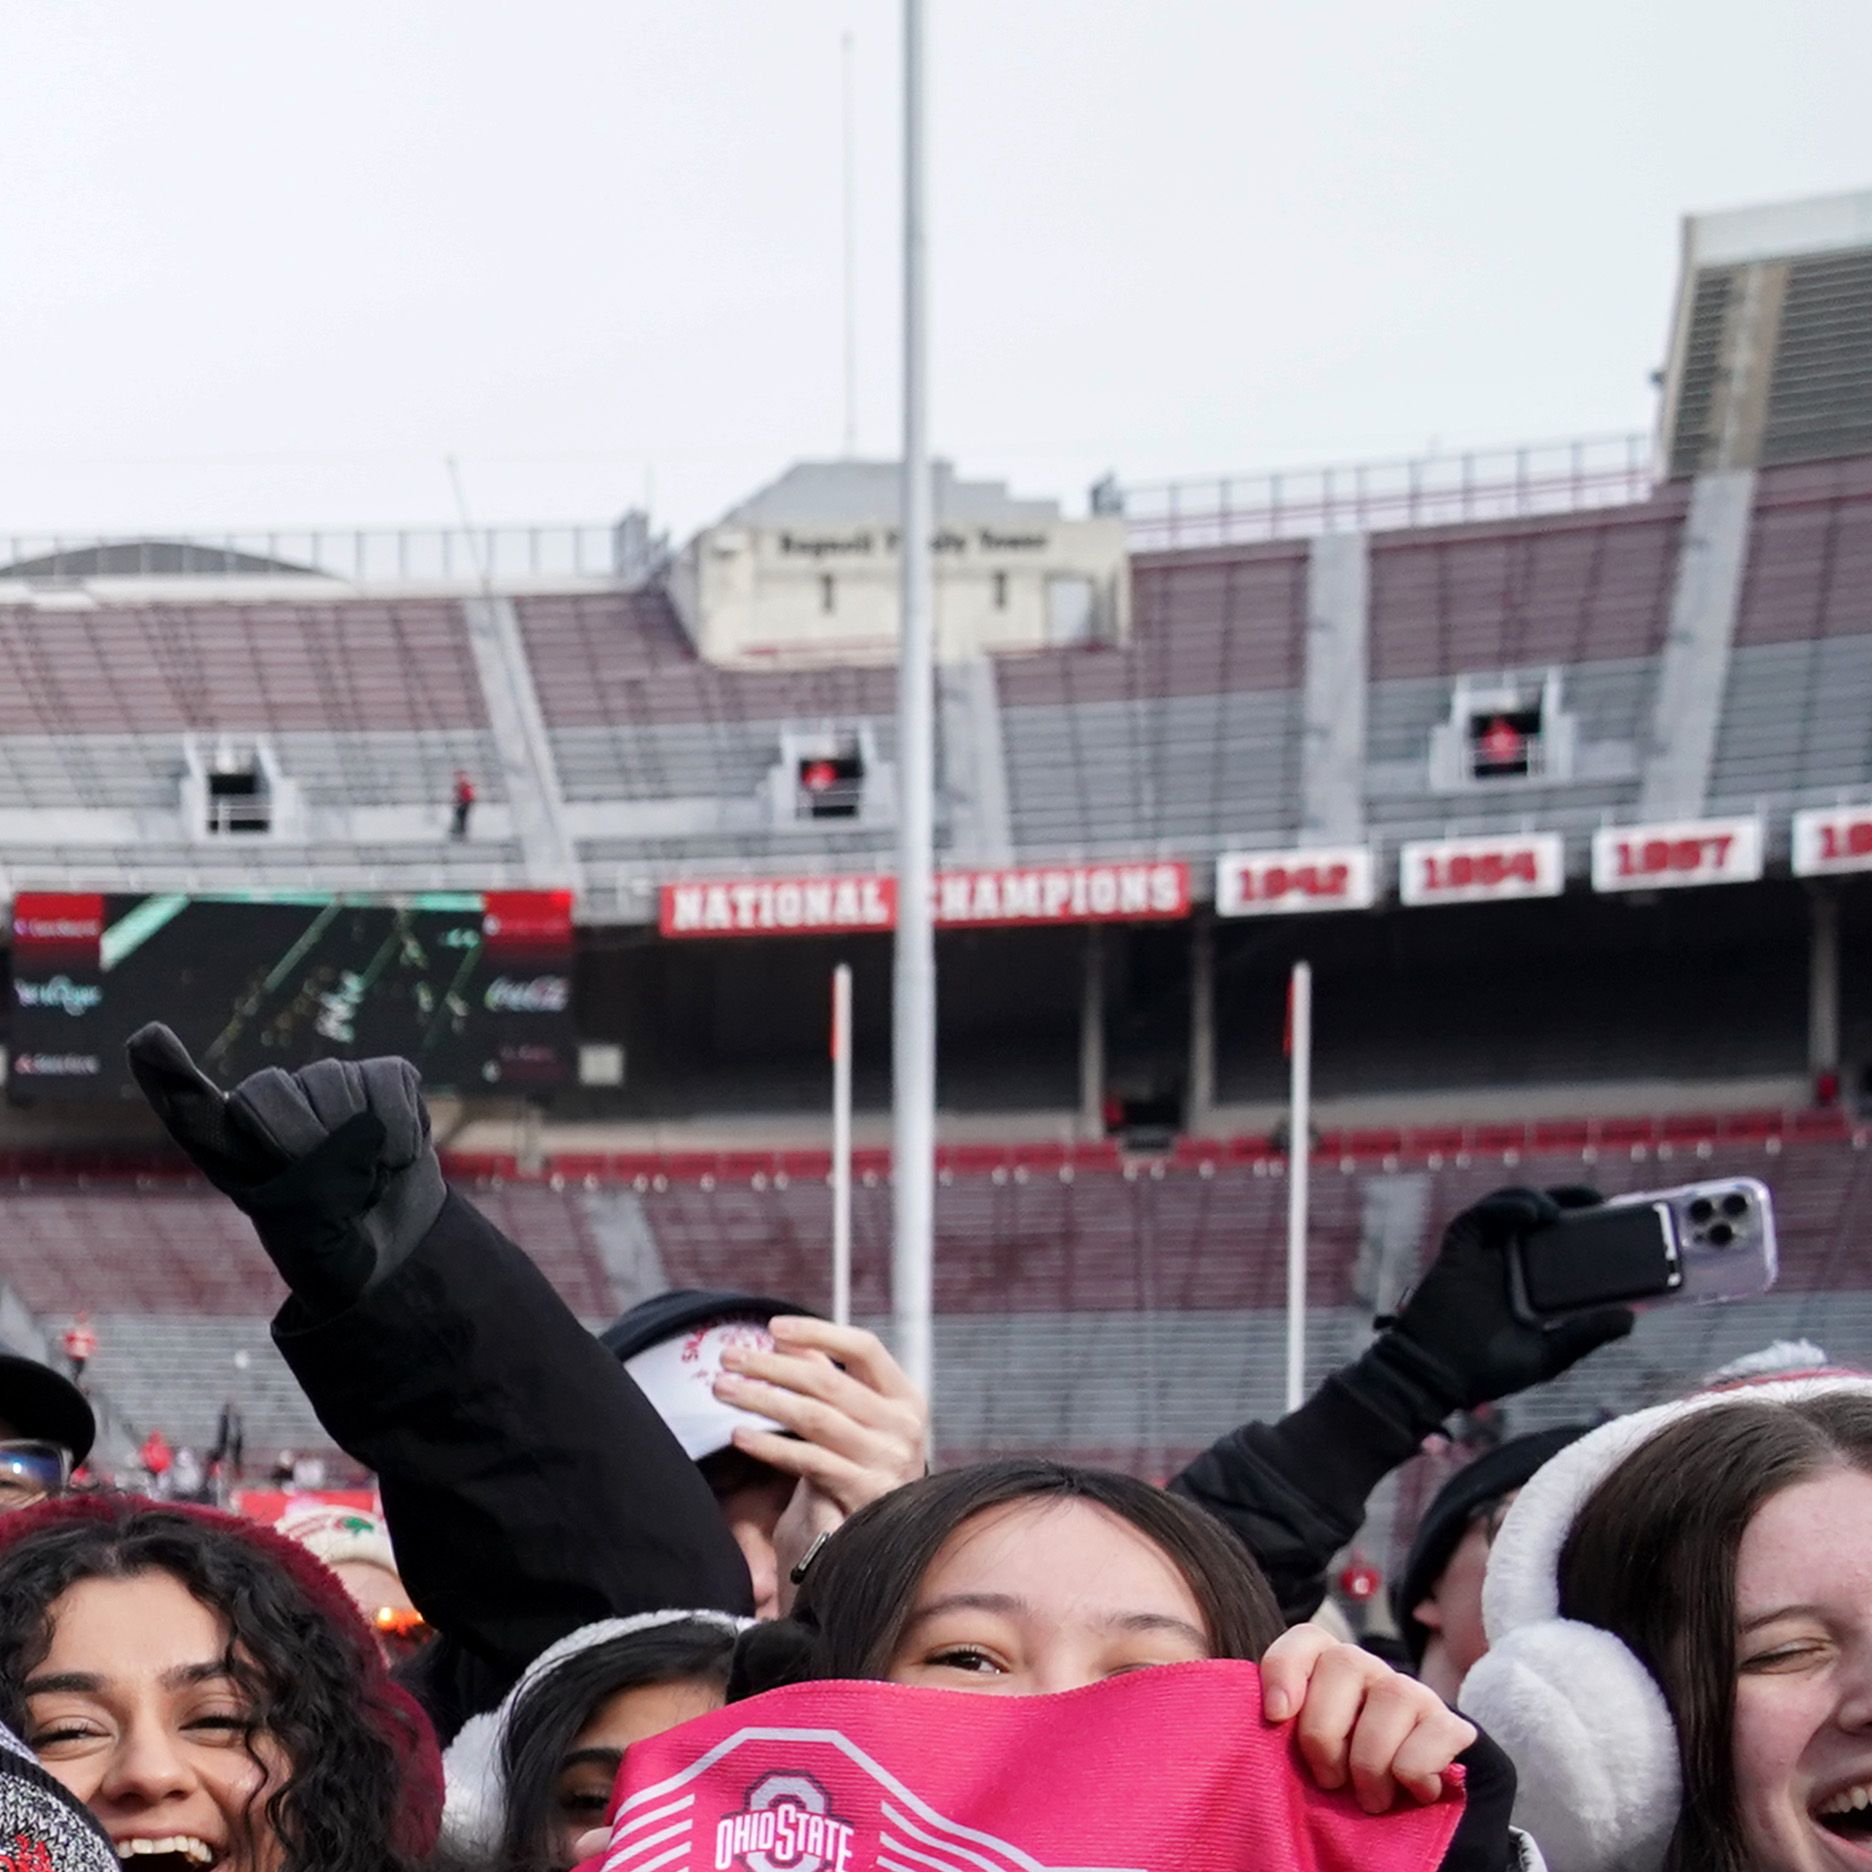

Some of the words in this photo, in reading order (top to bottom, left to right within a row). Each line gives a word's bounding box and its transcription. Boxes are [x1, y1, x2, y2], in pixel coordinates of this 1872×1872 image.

[672, 880, 888, 932] NATIONAL
[938, 864, 1181, 922] HAMPIONS
[715, 1811, 776, 1870] OHIO
